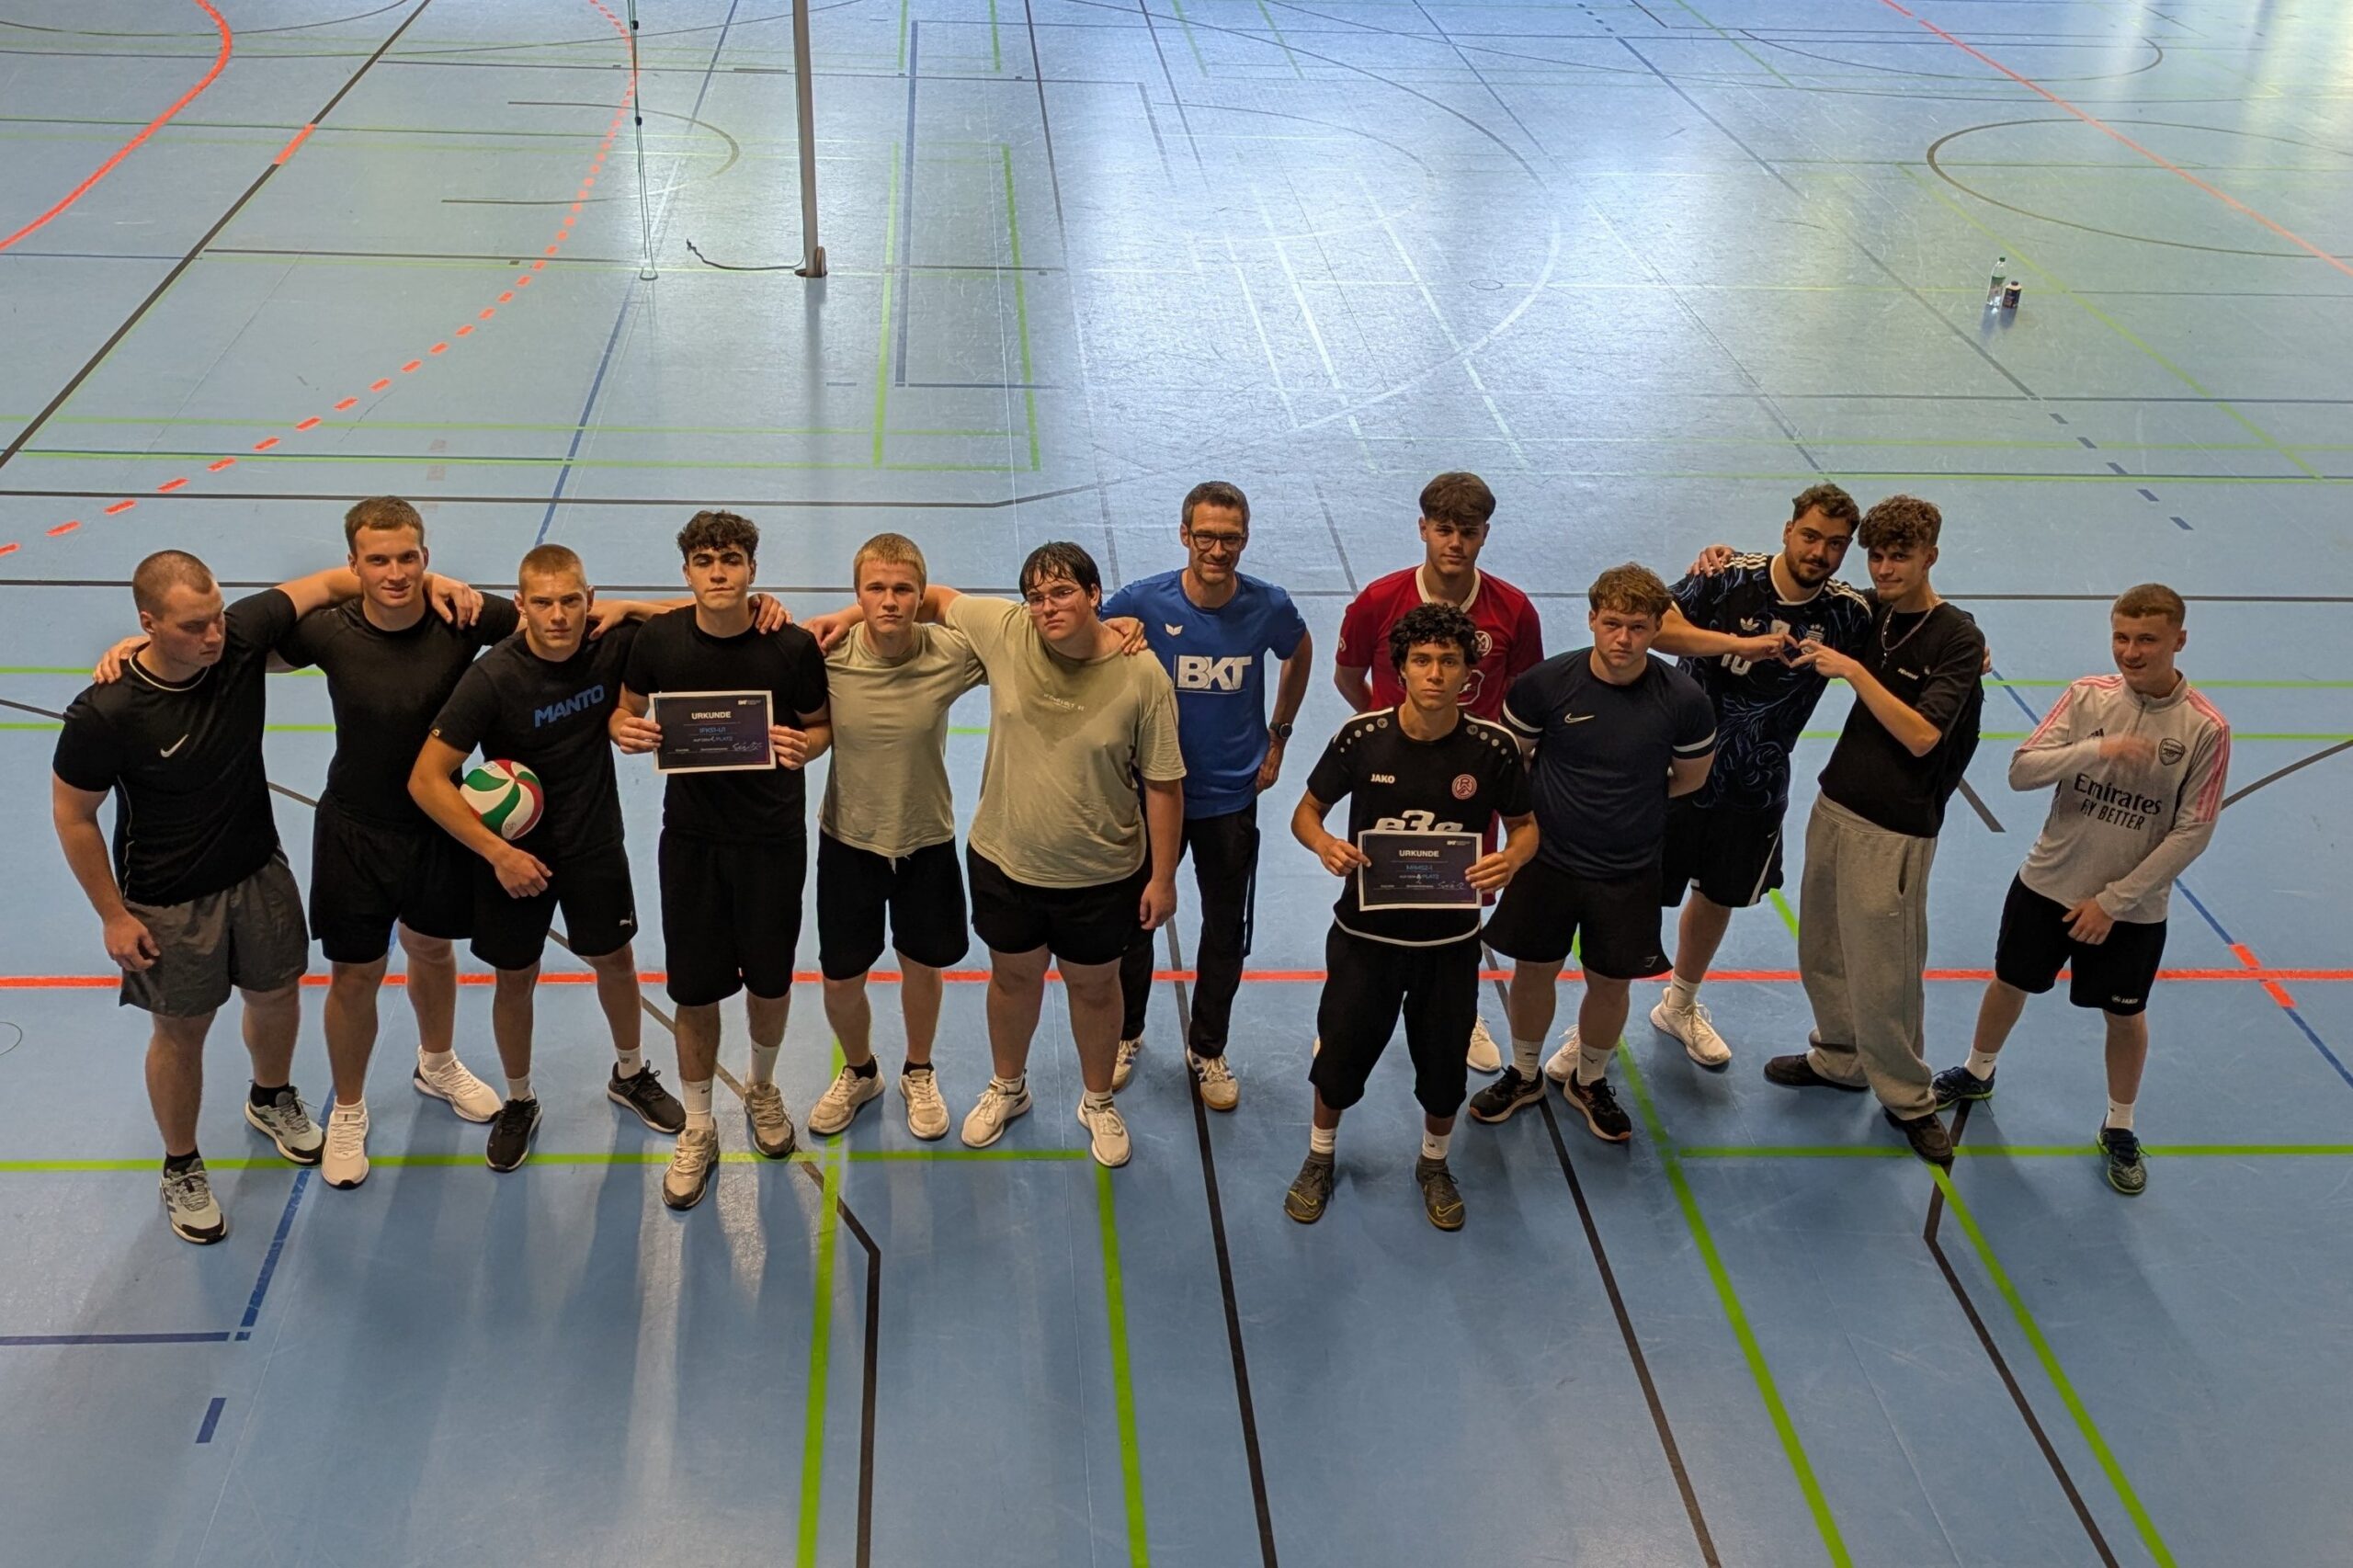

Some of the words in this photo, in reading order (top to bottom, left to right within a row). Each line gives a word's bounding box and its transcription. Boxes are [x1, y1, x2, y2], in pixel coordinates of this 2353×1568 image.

[1177, 655, 1252, 690] BKT
[534, 684, 605, 728] MANTO
[691, 711, 732, 720] URKUNDE
[1370, 773, 1395, 784] JAKO
[2074, 773, 2162, 816] Emirates
[2097, 805, 2145, 831] BETTER
[1399, 849, 1439, 858] URKUNDE
